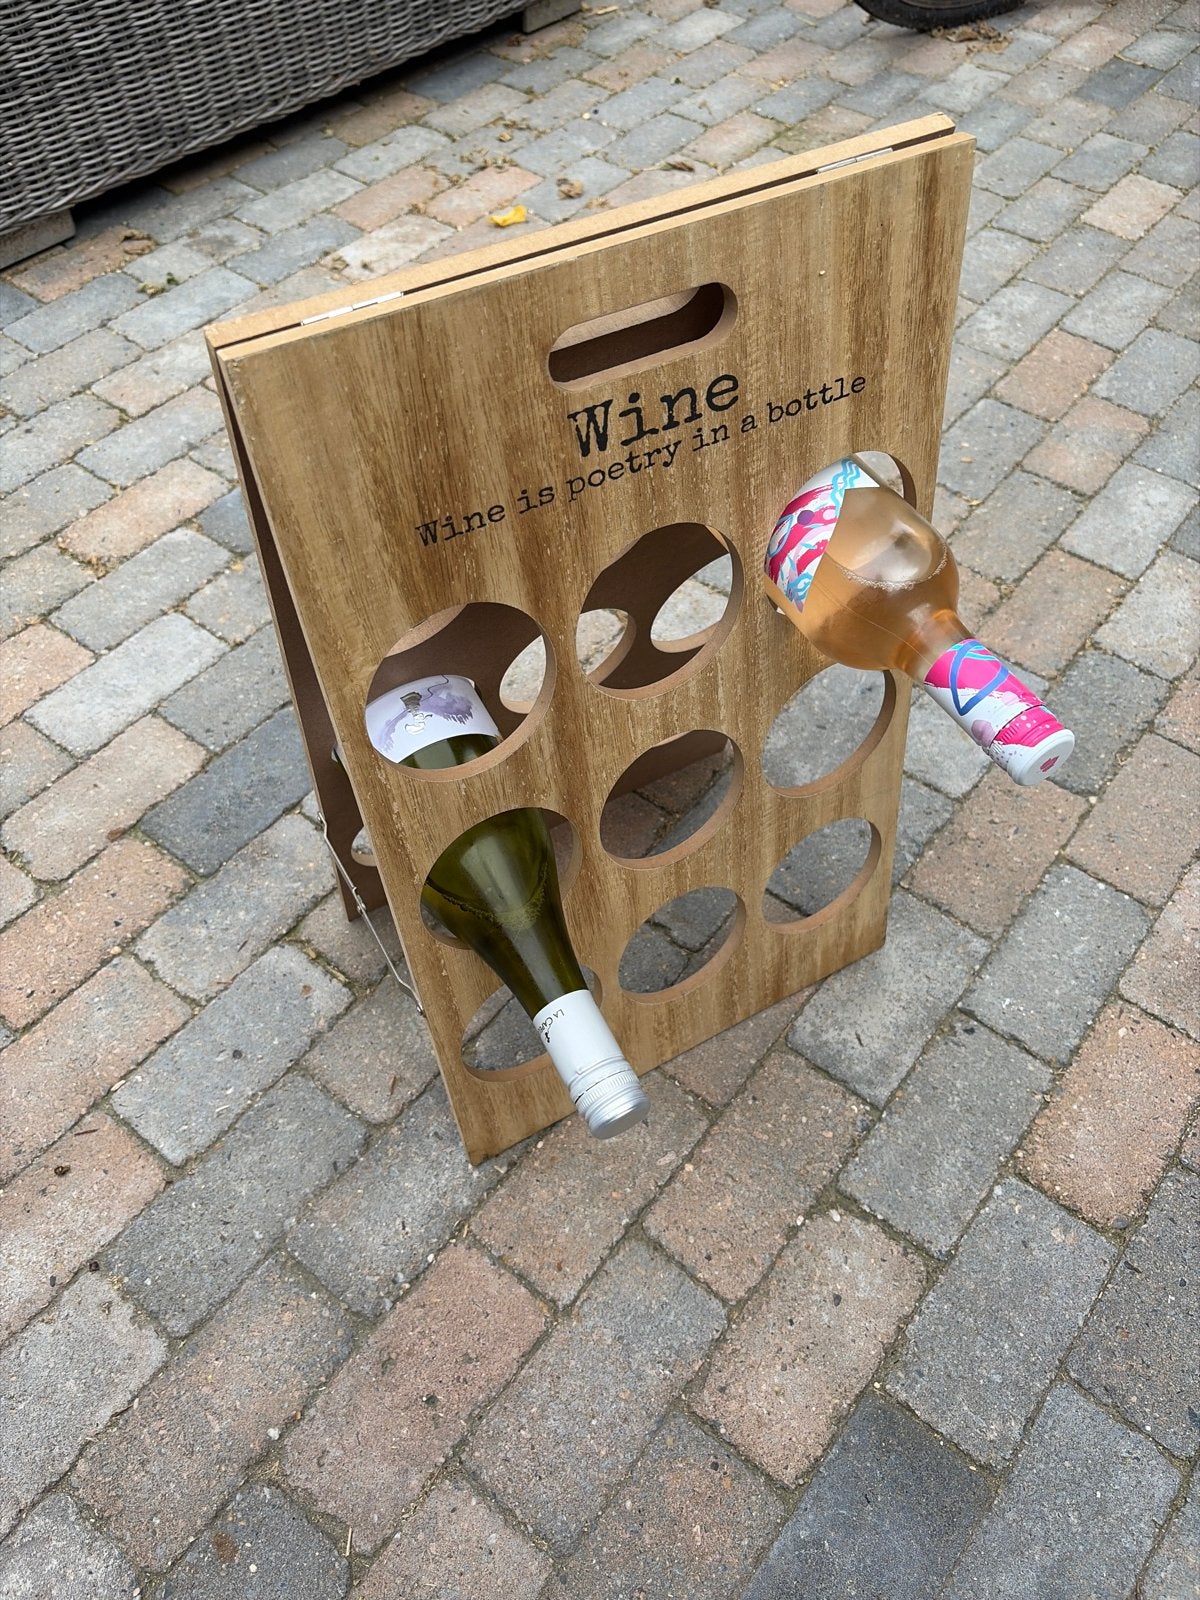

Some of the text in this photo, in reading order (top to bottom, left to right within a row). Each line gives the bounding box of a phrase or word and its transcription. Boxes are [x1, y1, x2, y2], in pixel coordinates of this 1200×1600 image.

[415, 376, 866, 546] Wine is poetry in a bottle
[567, 373, 739, 457] Wine
